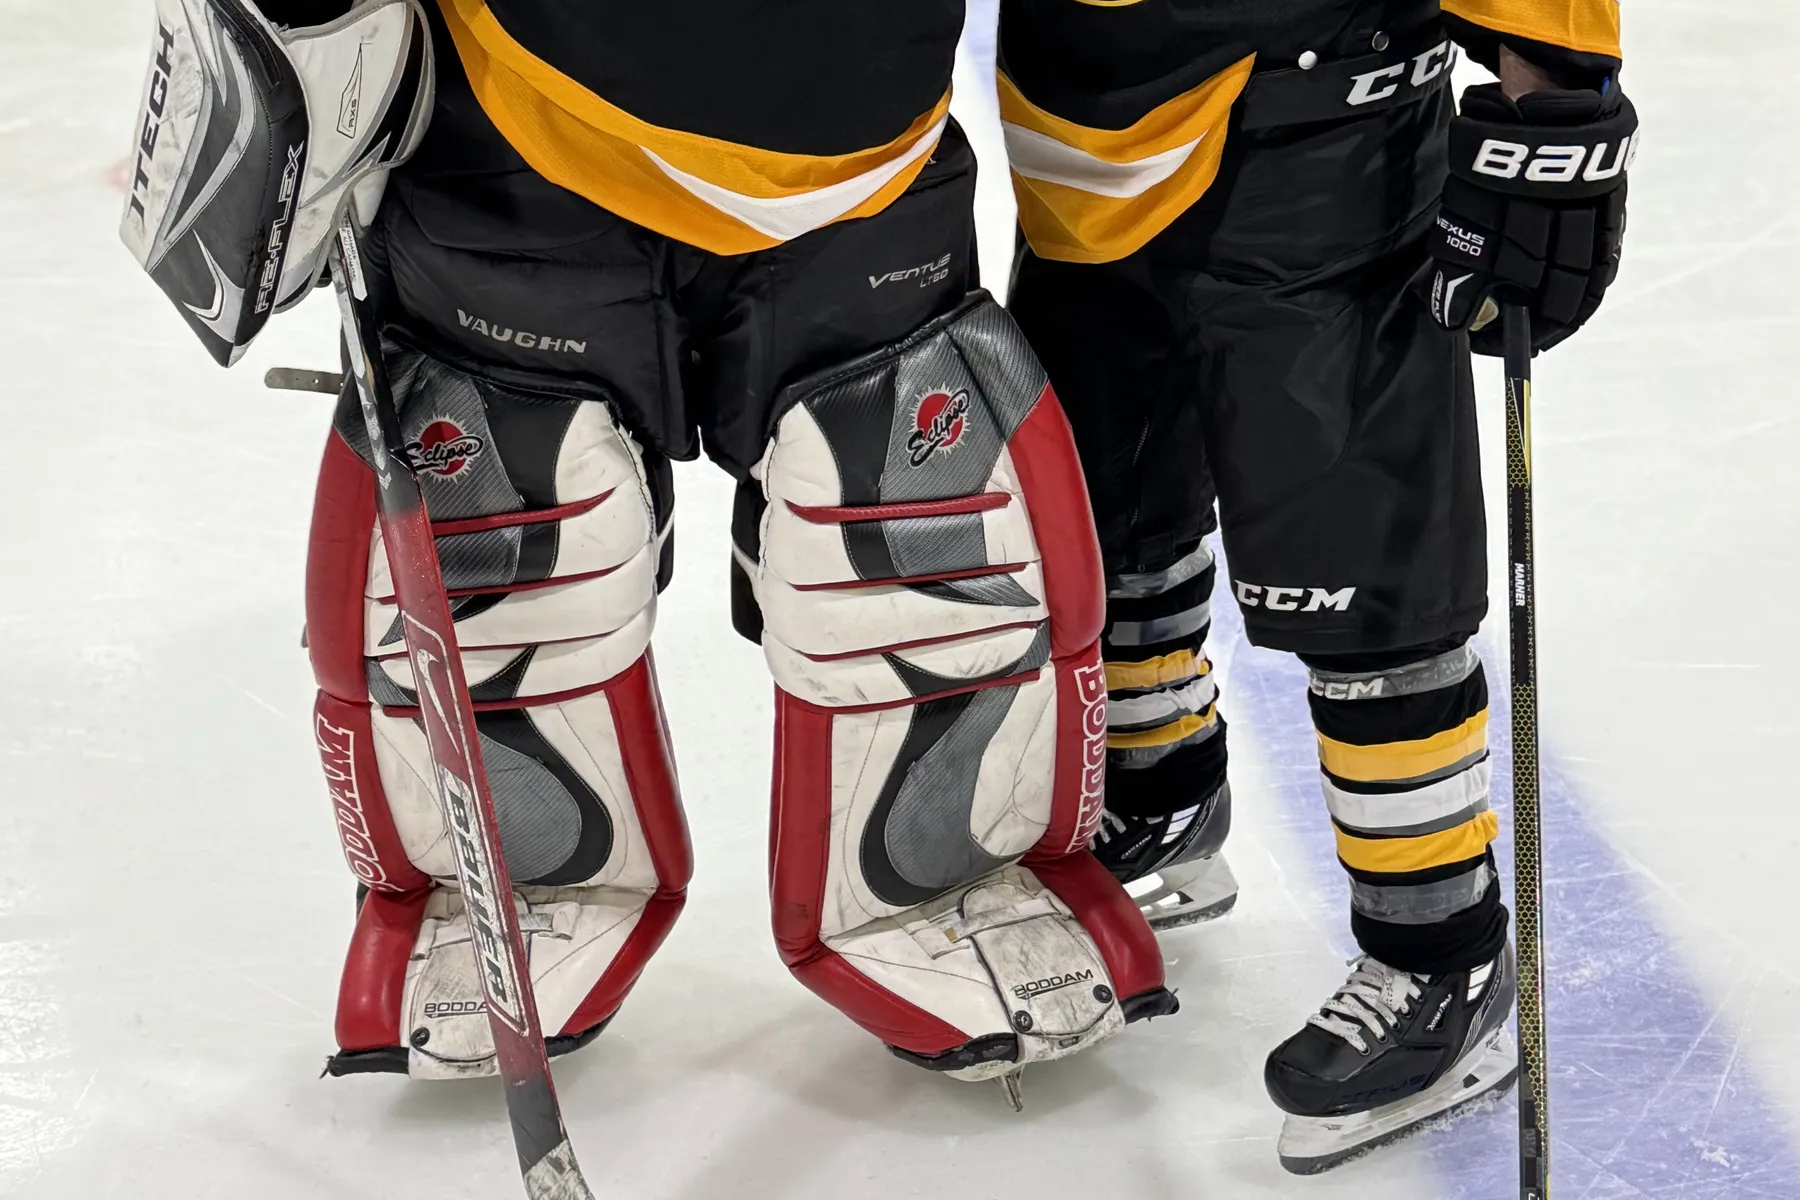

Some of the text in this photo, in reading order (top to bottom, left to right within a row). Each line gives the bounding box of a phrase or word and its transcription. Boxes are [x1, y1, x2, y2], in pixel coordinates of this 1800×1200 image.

[1346, 40, 1456, 106] CC
[127, 18, 174, 224] ITECH
[1446, 235, 1481, 256] 1000
[868, 252, 951, 289] VENTUS
[457, 308, 587, 353] VAUGHN
[906, 387, 970, 468] Eclipse
[405, 434, 484, 473] Eclipse
[1234, 579, 1357, 612] CCM
[1514, 562, 1526, 607] MARNER
[1310, 675, 1384, 700] CCM
[1011, 968, 1094, 997] BODDAM
[424, 1001, 488, 1014] BODDA
